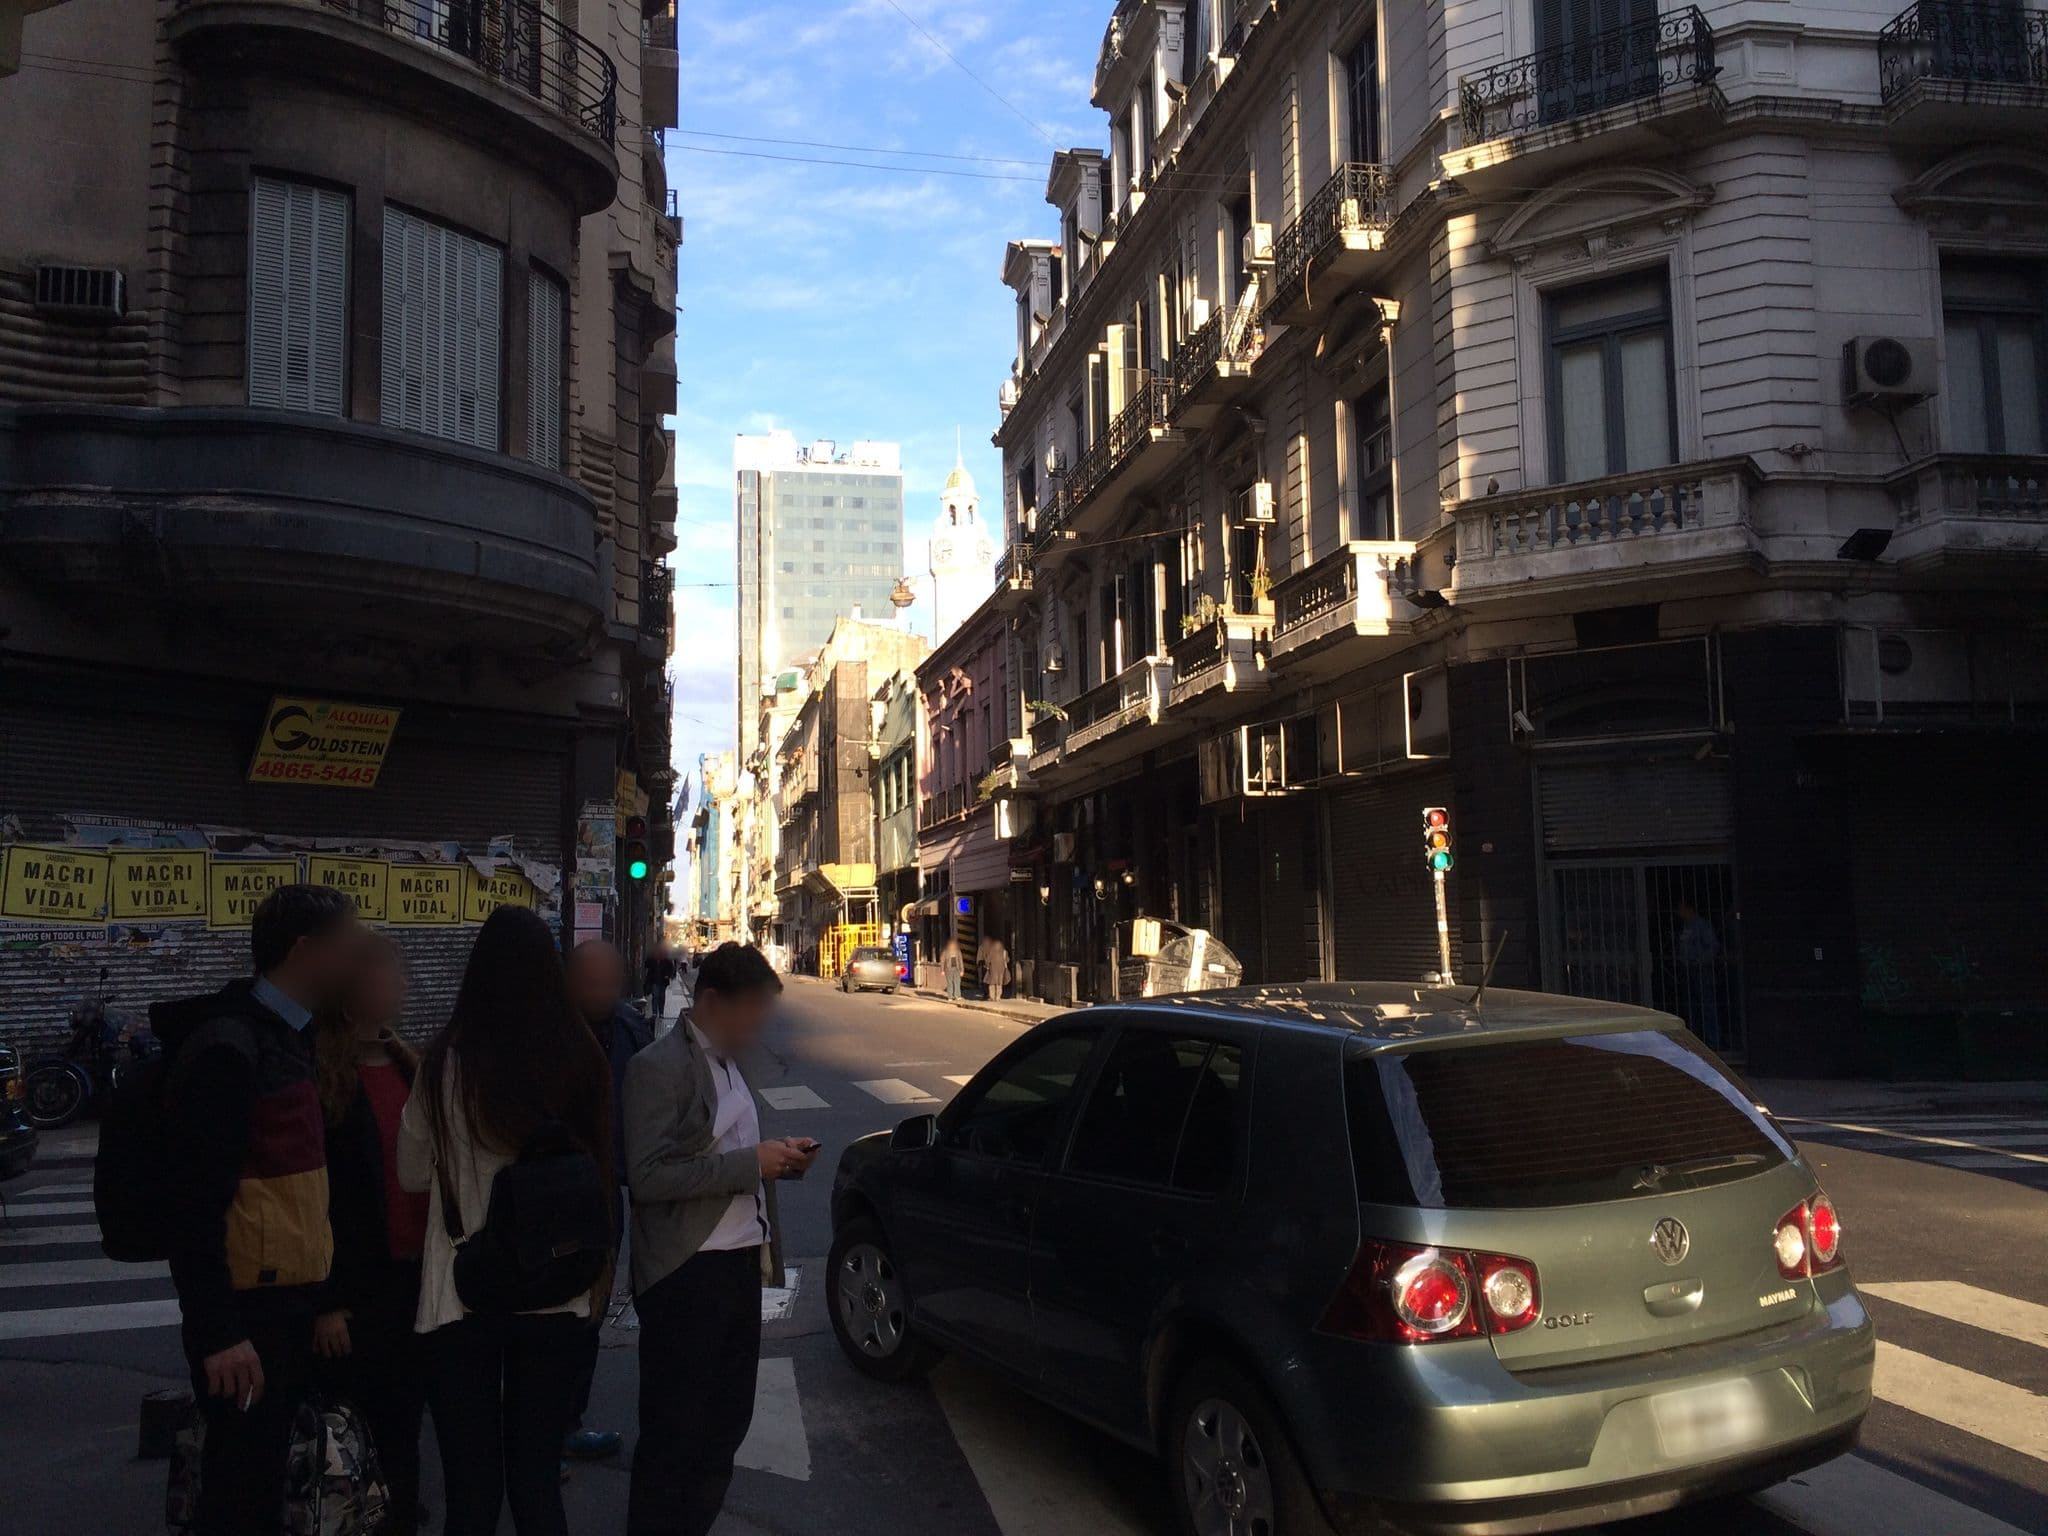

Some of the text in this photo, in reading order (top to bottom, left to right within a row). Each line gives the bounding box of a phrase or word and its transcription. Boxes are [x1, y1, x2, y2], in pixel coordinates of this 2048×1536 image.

[327, 710, 390, 726] ALQUILA
[269, 705, 386, 756] GOLDSTEIN
[255, 759, 376, 784] 4865-5445
[24, 862, 94, 885] MACRI
[128, 864, 192, 881] MACRI
[322, 870, 376, 887] MACRI
[225, 876, 283, 891] MACRI
[401, 879, 449, 893] MACRI
[477, 879, 523, 898] MACRI
[25, 888, 87, 909] VIDAL
[131, 889, 189, 906] VIDAL
[228, 899, 258, 914] VID
[403, 899, 447, 914] VIDAL
[40, 931, 51, 941] EN
[53, 931, 74, 941] TODO
[75, 930, 85, 940] EL
[1759, 1288, 1797, 1307] MAYNAR
[1543, 1312, 1594, 1330] GOLF
